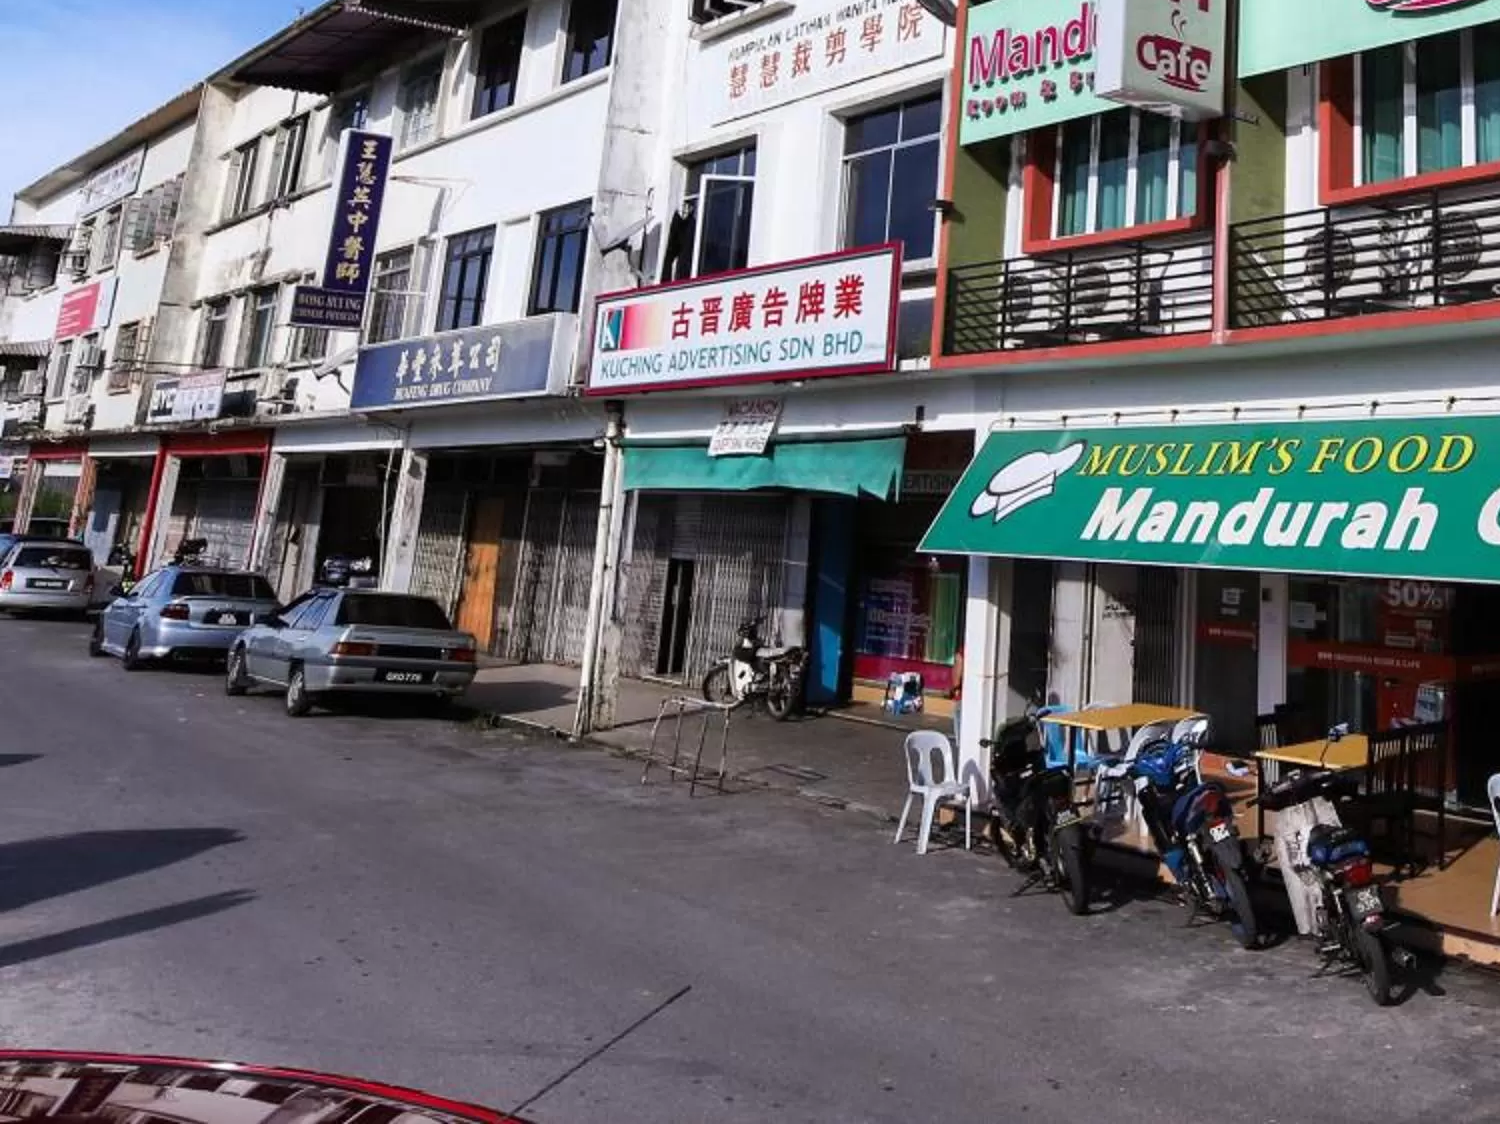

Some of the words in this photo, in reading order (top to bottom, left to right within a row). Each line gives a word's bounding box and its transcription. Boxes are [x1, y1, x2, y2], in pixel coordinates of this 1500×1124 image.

[1136, 32, 1211, 81] Cafe
[601, 351, 663, 380] KUCHING
[669, 341, 772, 373] ADVERTISING
[779, 336, 815, 362] SDN
[823, 330, 864, 355] BHD
[1078, 436, 1299, 477] MUSLIM'S
[1307, 432, 1476, 475] FOOD
[1080, 486, 1440, 552] Mandurah
